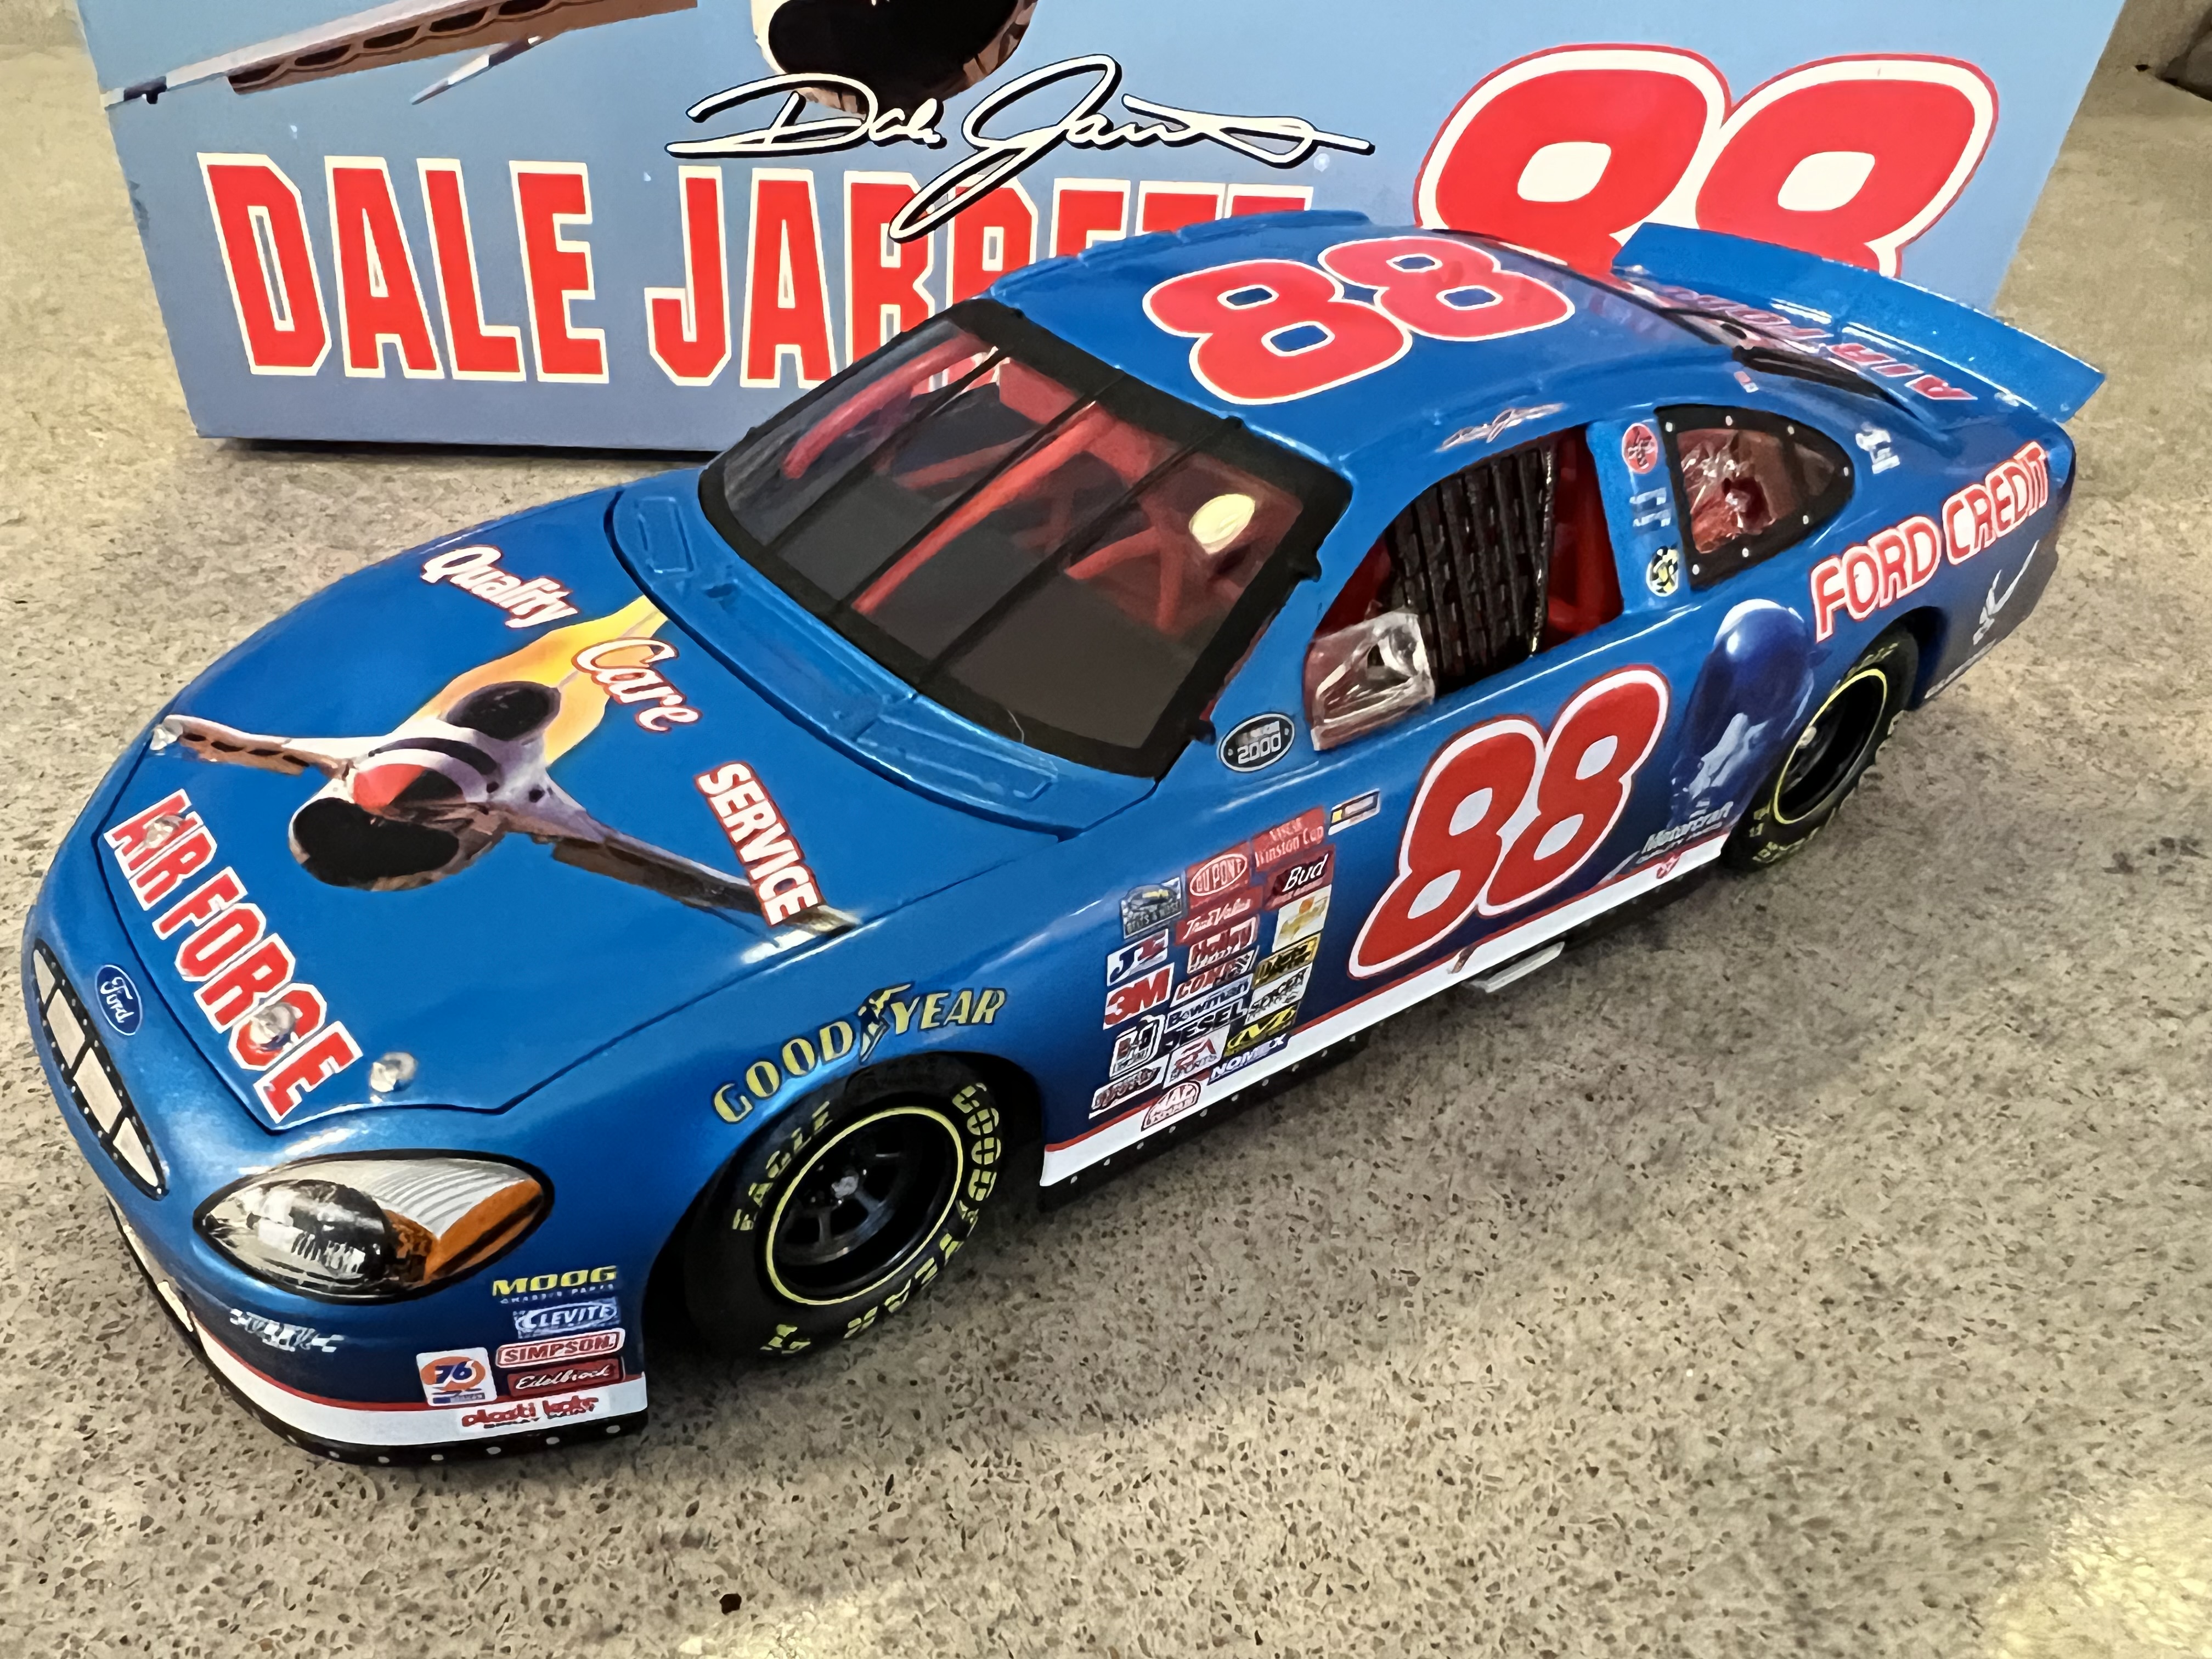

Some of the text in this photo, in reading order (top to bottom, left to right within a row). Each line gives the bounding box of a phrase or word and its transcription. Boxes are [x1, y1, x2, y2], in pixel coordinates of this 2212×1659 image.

[197, 152, 609, 384] DALE
[1142, 236, 1575, 405] 88
[1810, 441, 2050, 643] FORD CREDIT
[421, 544, 580, 629] Quality
[572, 637, 703, 732] Care
[1237, 732, 1281, 764] 2000
[103, 788, 218, 911] AIR
[695, 761, 825, 927] SERVICE
[1255, 834, 1300, 868] Winston
[1347, 664, 1671, 980] 88
[1281, 853, 1329, 893] Bud
[100, 977, 134, 1023] Ford
[151, 866, 364, 1124] FORCE
[1105, 968, 1172, 1026] 3M
[492, 1265, 617, 1296] MOOG
[521, 1305, 616, 1331] CLEVITE
[435, 1360, 475, 1385] 76
